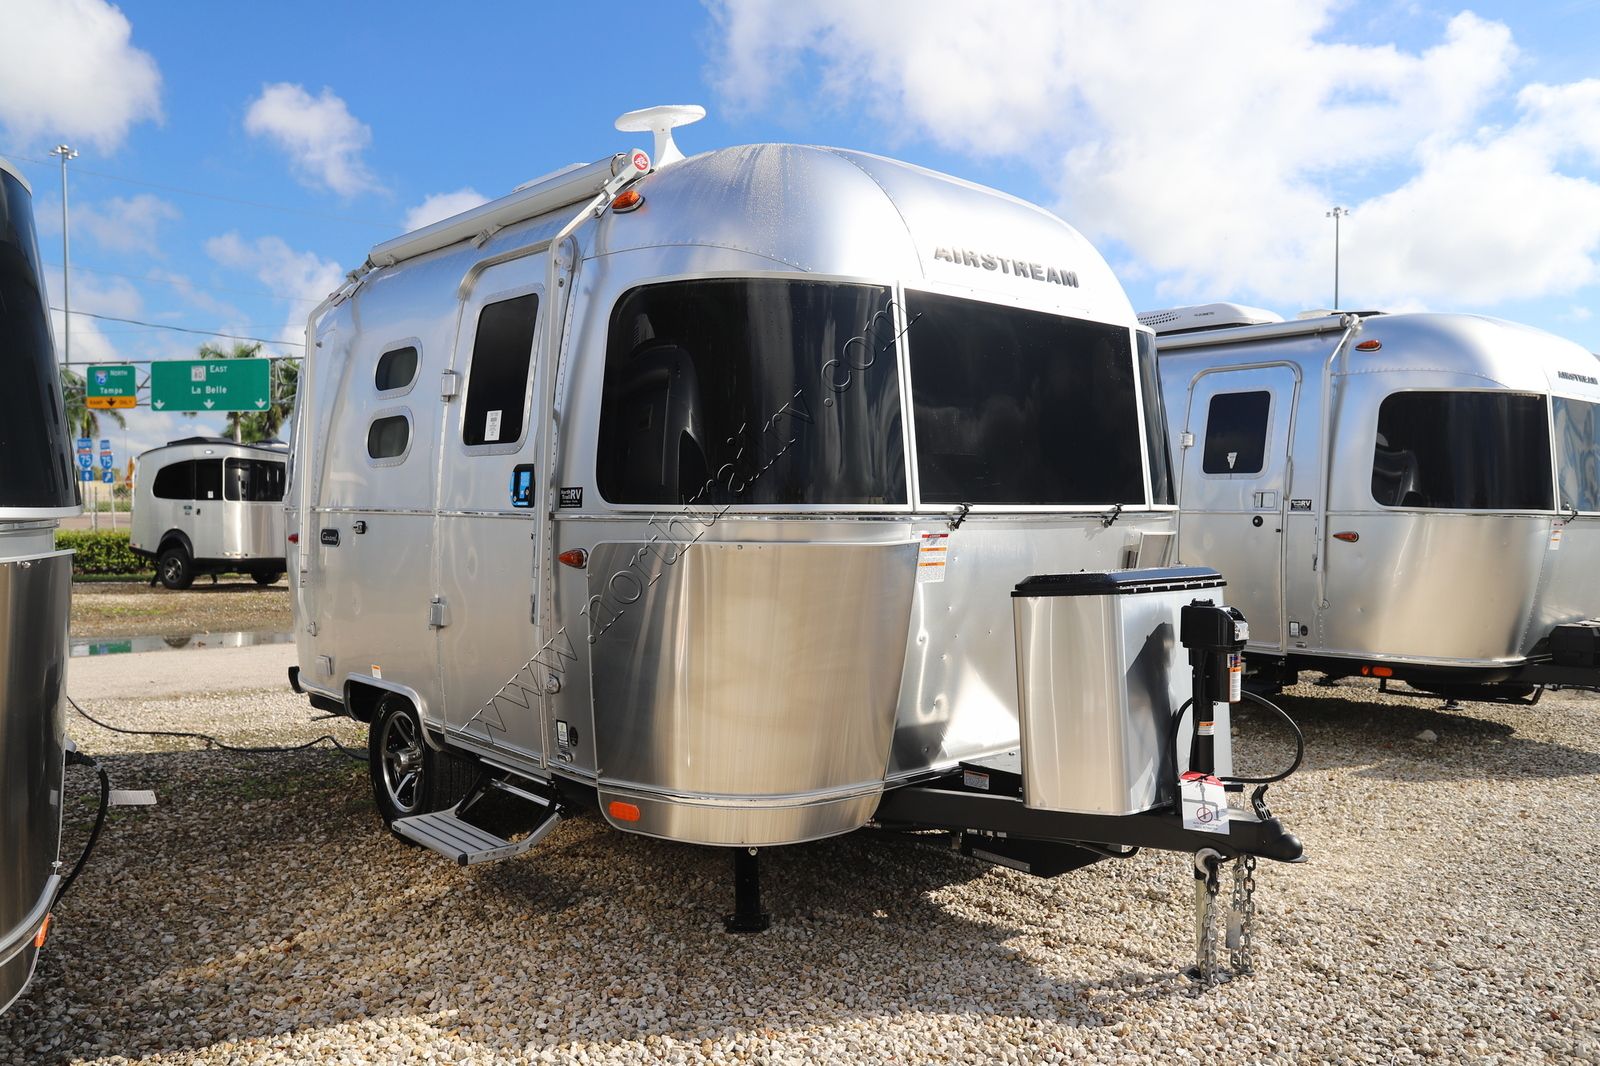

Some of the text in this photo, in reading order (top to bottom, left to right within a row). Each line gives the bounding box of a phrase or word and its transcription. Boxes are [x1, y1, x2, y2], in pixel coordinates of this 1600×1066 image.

[934, 245, 1079, 288] AIRSTREAM
[209, 364, 228, 373] EAST
[100, 387, 123, 396] Tampa
[191, 385, 228, 395] La Belle
[80, 455, 91, 466] 75
[101, 456, 112, 467] 75
[570, 488, 582, 500] RV
